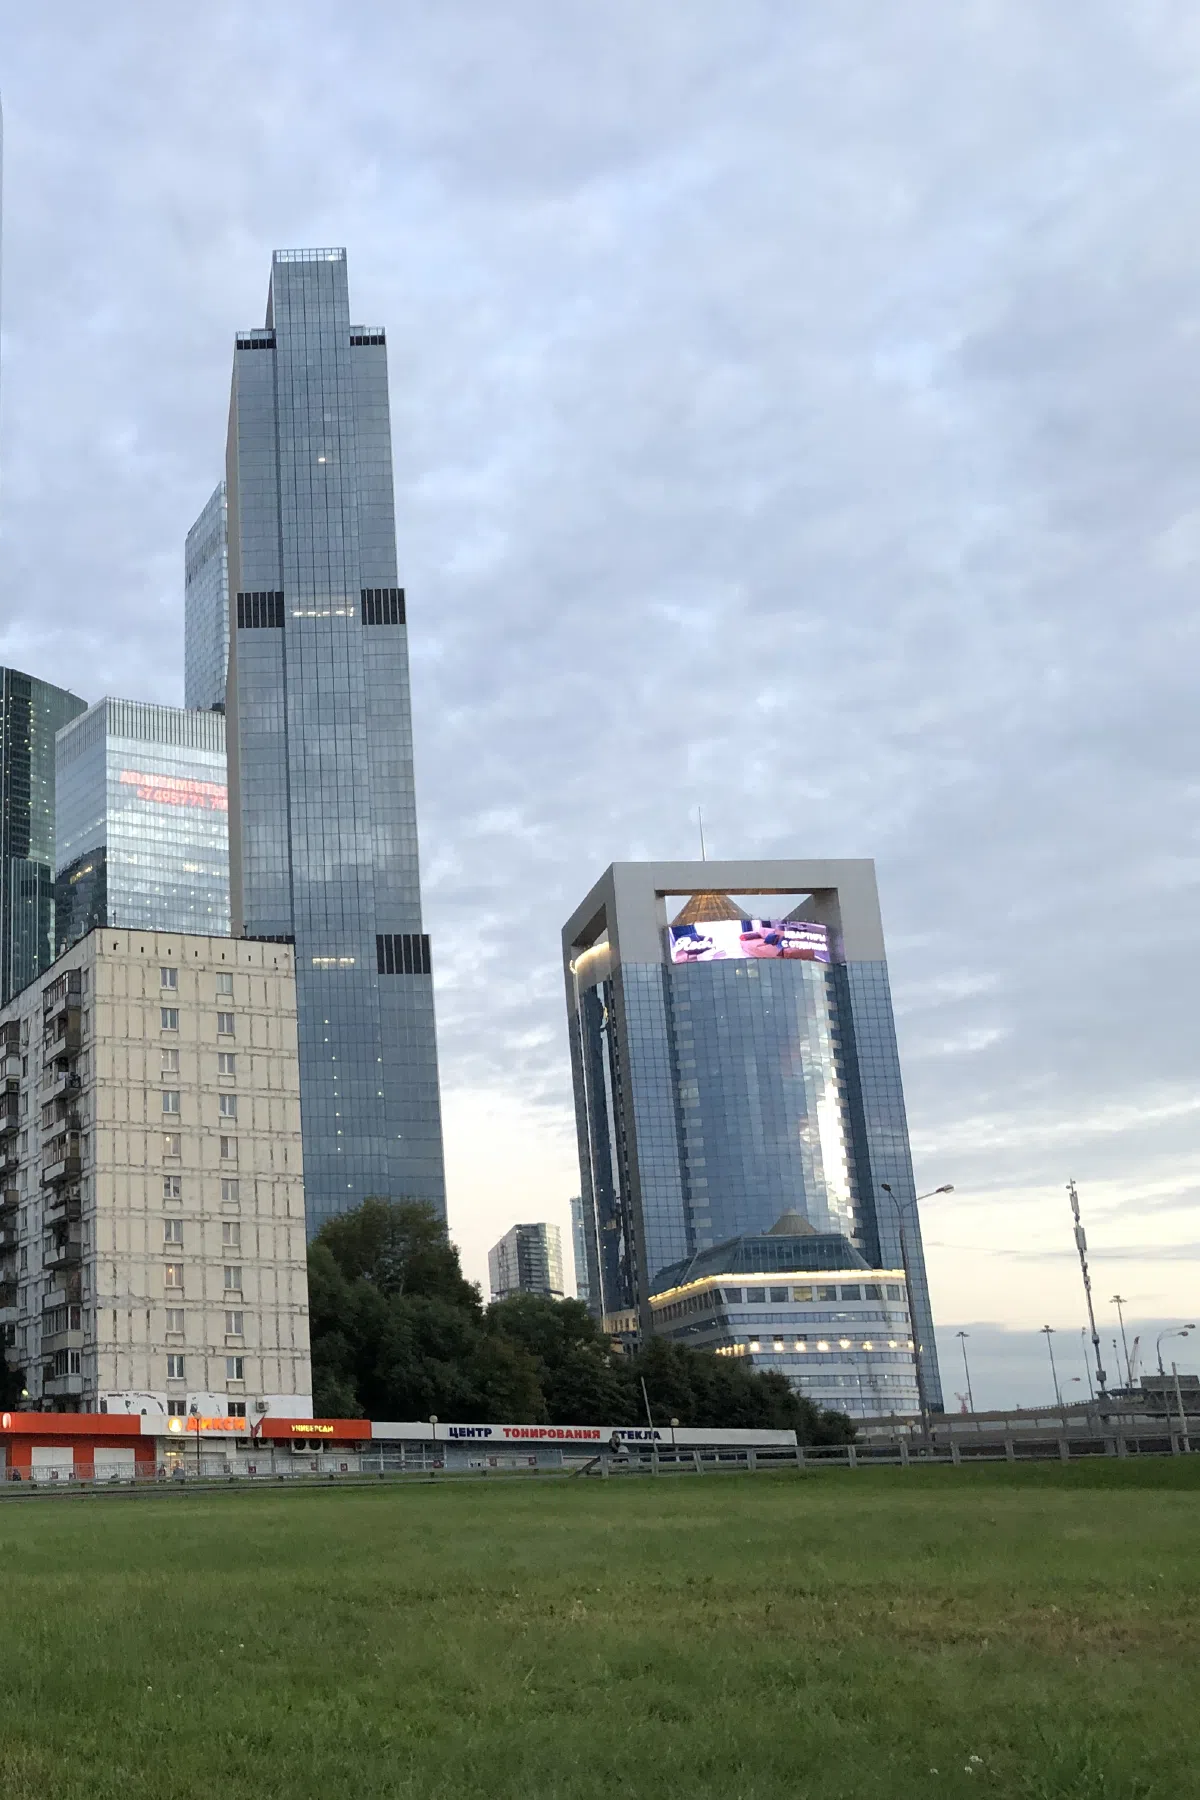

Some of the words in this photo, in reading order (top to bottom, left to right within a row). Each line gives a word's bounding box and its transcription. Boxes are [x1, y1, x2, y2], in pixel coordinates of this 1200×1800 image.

[186, 1416, 246, 1432] ДИКСИ
[291, 1424, 334, 1434] УНИВЕРСАМ
[449, 1427, 492, 1439] ЦЕНТР
[503, 1427, 601, 1439] ТОНИРОВАНИЯ
[612, 1430, 662, 1440] ТЕКЛА
